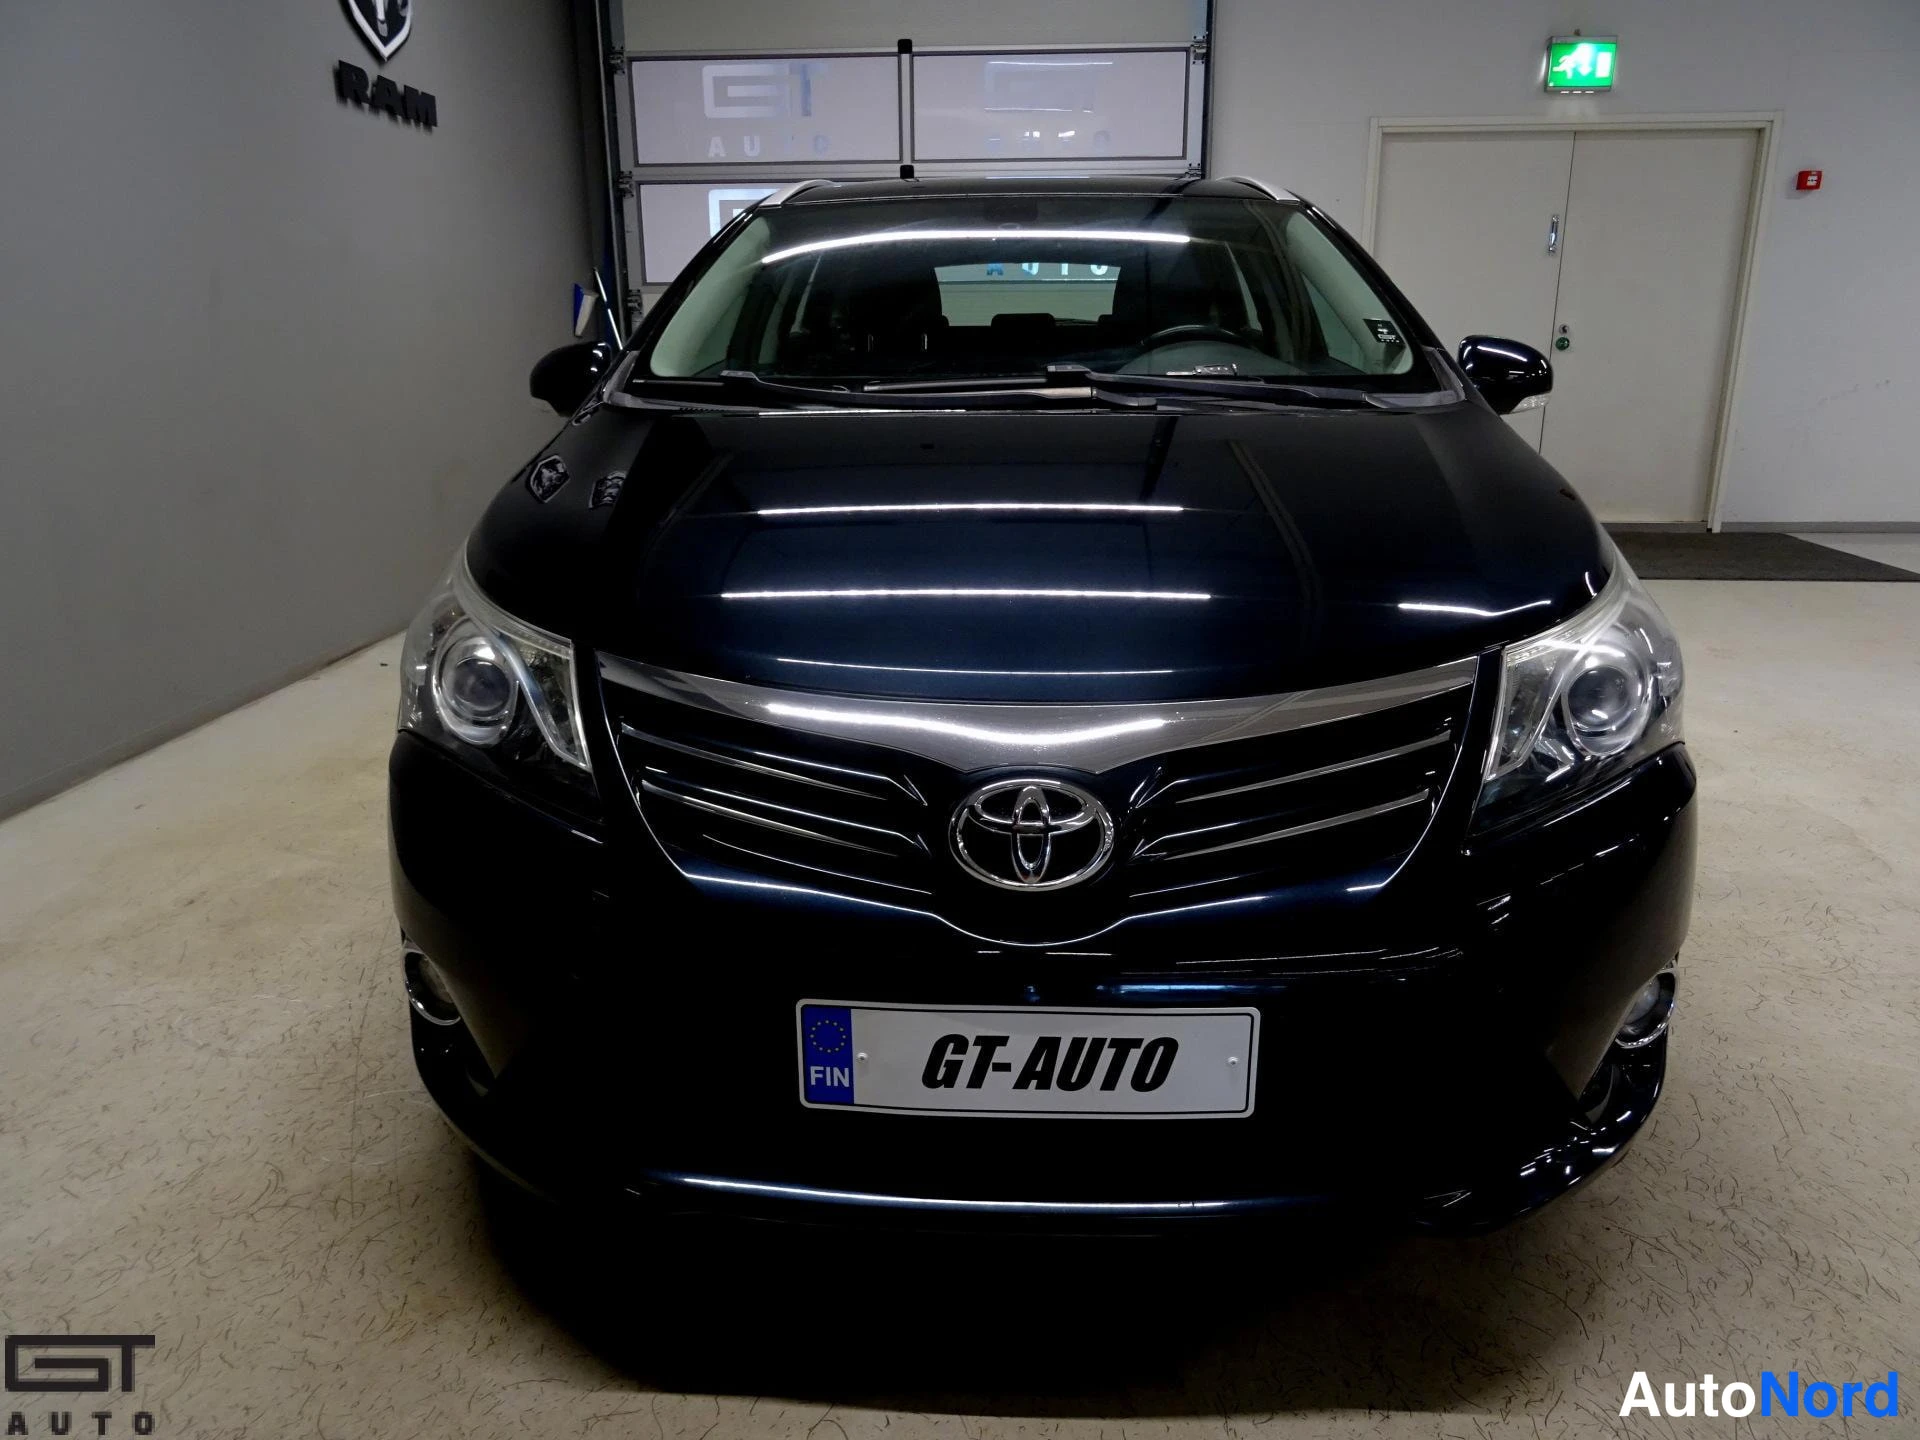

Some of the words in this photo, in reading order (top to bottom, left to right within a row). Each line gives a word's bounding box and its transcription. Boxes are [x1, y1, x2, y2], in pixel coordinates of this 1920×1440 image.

[335, 59, 438, 130] RAM
[707, 136, 829, 157] AUO
[810, 1066, 850, 1087] FIN
[921, 1033, 1179, 1093] GT-AUTO
